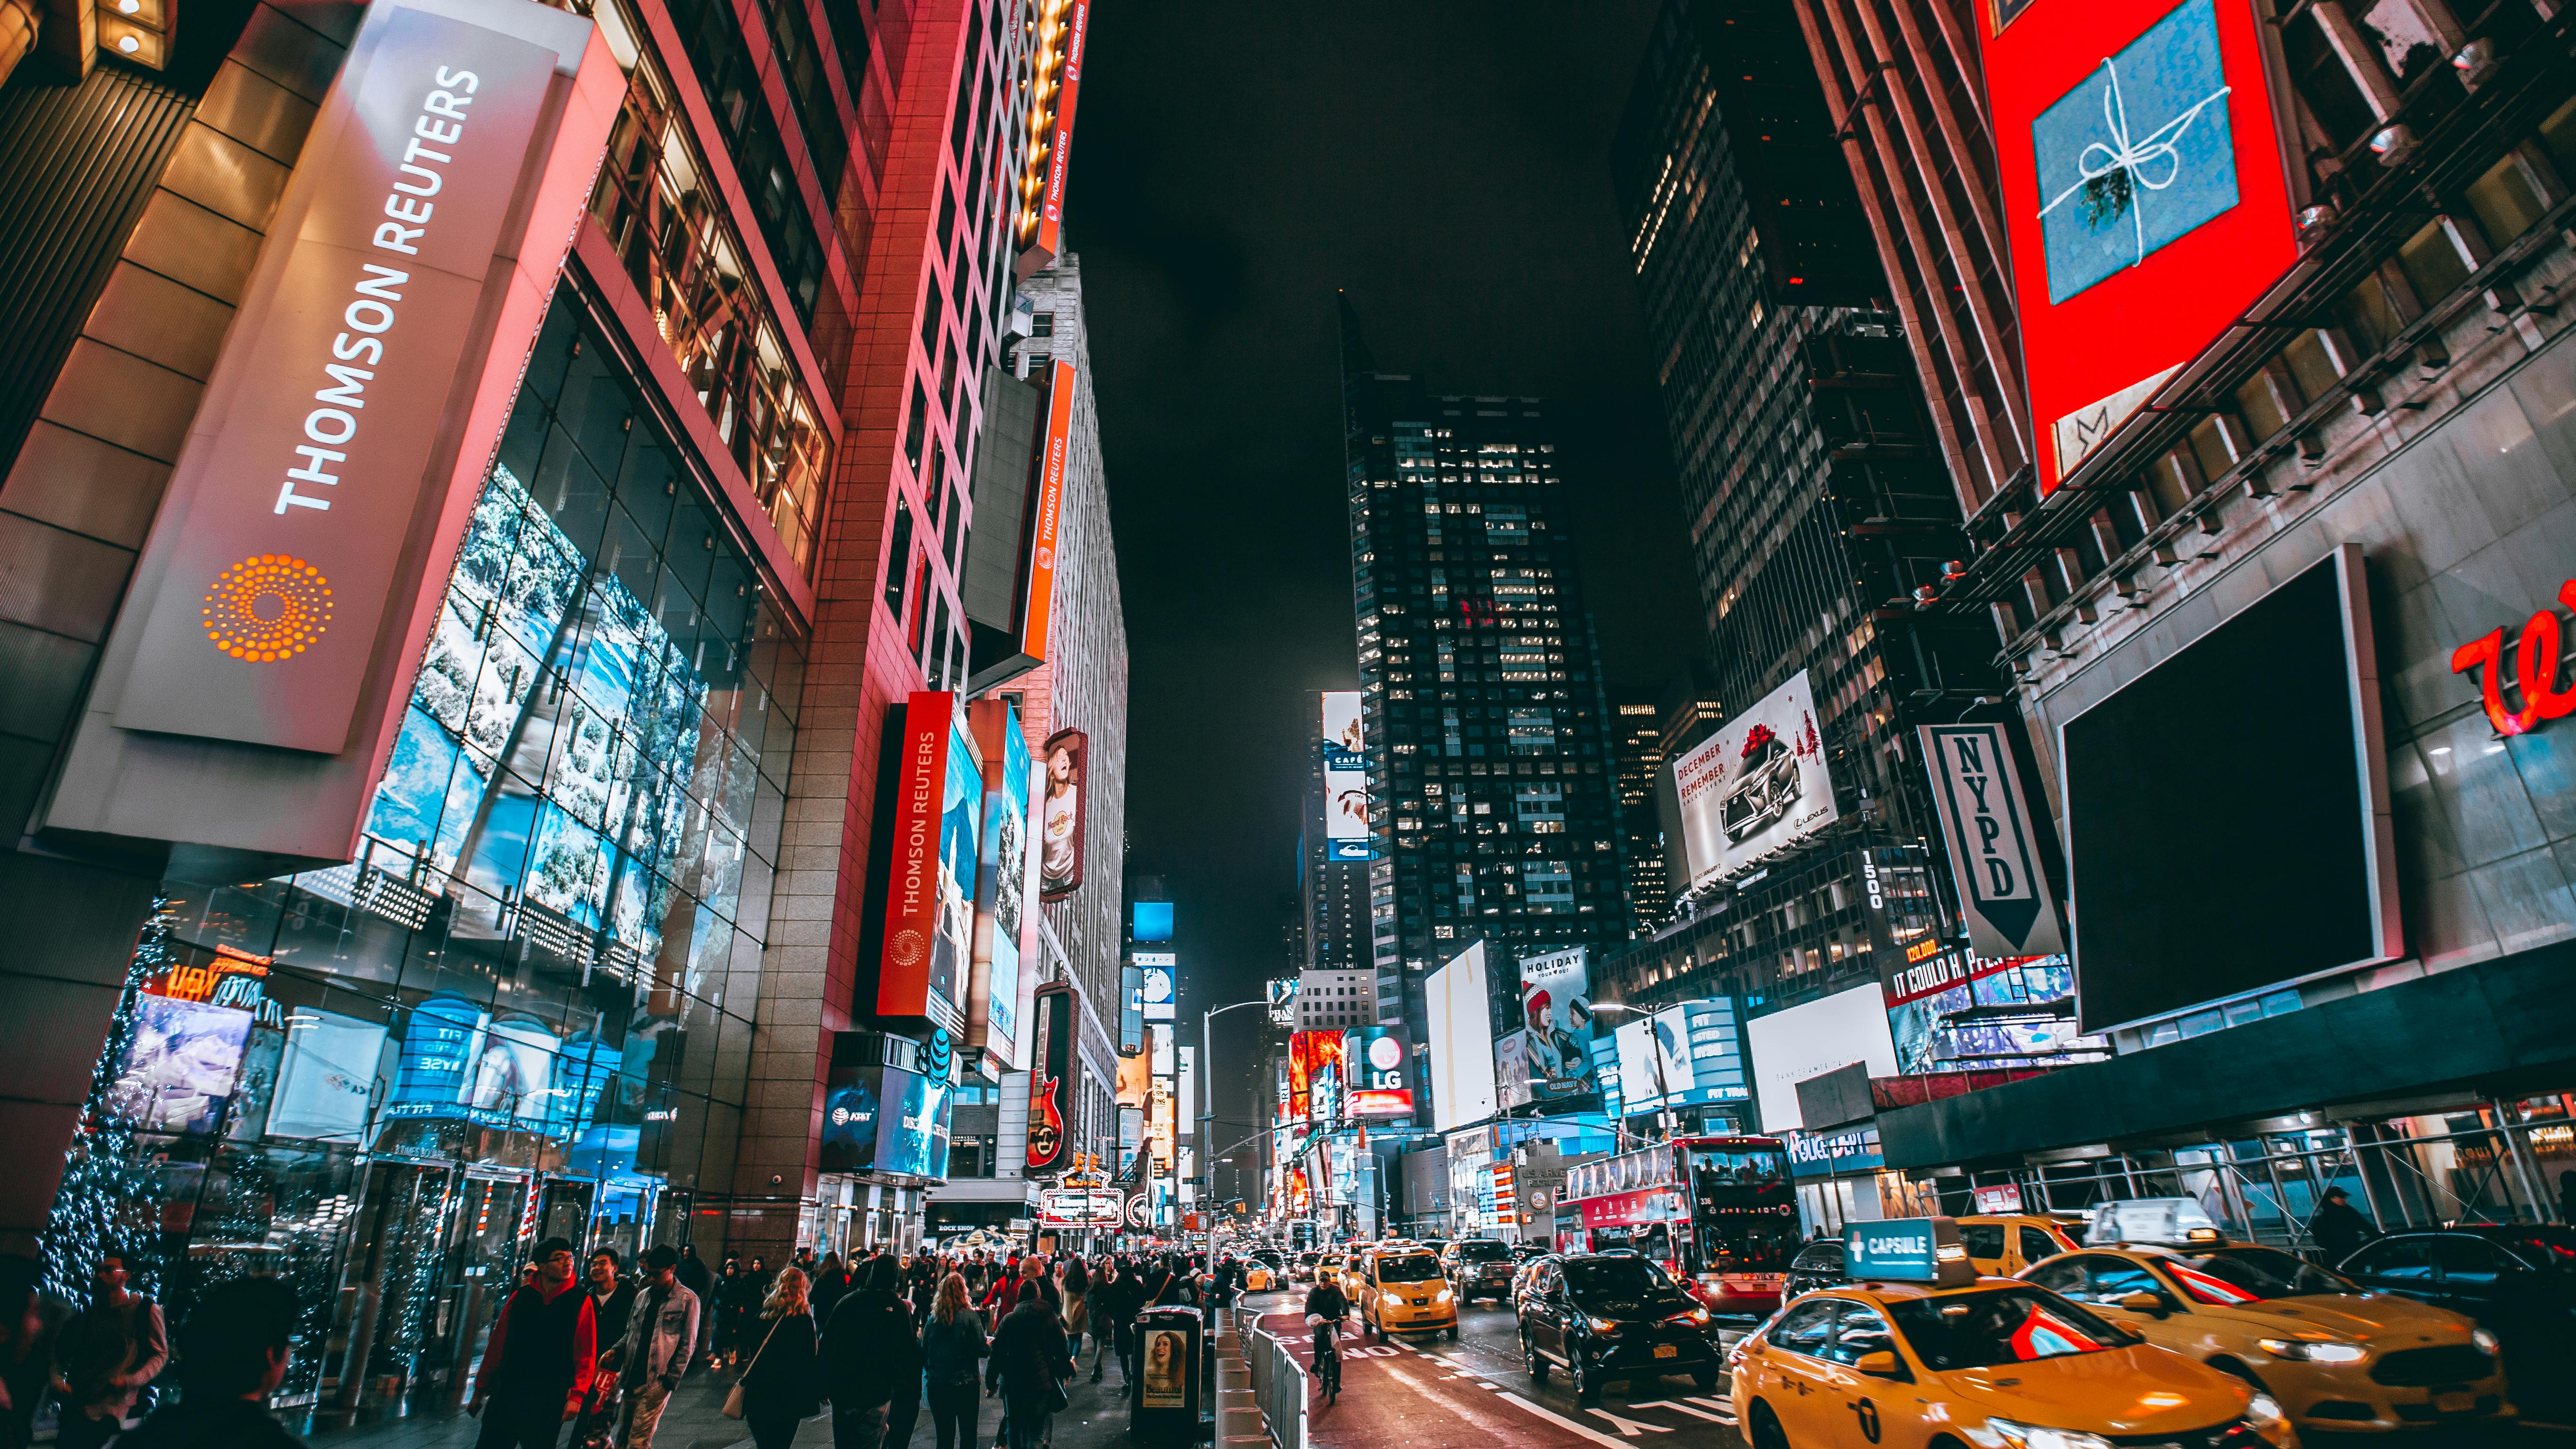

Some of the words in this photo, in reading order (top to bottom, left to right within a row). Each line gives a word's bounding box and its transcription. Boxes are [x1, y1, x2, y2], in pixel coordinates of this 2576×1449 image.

[1051, 163, 1063, 201] THOMSON
[1057, 130, 1067, 163] REUTERS
[274, 263, 409, 515] THOMSON
[373, 64, 480, 255] REUTERS
[1049, 436, 1063, 485] REUTERS
[1043, 485, 1057, 540] THOMSON
[913, 732, 934, 813] REUTERS
[1335, 755, 1363, 764] CAFÉ
[1678, 743, 1721, 781] DECEMBER
[1681, 763, 1724, 799] REMEMBER
[1683, 791, 1701, 806] SALES
[1706, 775, 1726, 791] EVENT
[1047, 817, 1060, 830] Hard
[1061, 811, 1073, 824] Rock
[1803, 806, 1828, 824] LEXUS
[1953, 736, 2014, 898] NYPD
[903, 821, 926, 917] THOMSON
[1695, 873, 1703, 881] ENDS
[1703, 865, 1718, 878] JANUARY
[1862, 850, 1883, 909] 1500
[1527, 955, 1578, 973] HOLIDAY
[1907, 939, 1937, 963] 120,000
[1893, 972, 1906, 998] IT
[1907, 958, 1948, 993] COULD
[1373, 1071, 1401, 1089] LG
[1561, 1080, 1577, 1088] NAVY
[850, 1112, 871, 1121] AT&T
[1121, 1112, 1142, 1124] BUBBA
[1122, 1126, 1140, 1135] GUMP
[1789, 1131, 1829, 1164] POLICE
[1868, 1236, 1927, 1254] CAPSULE
